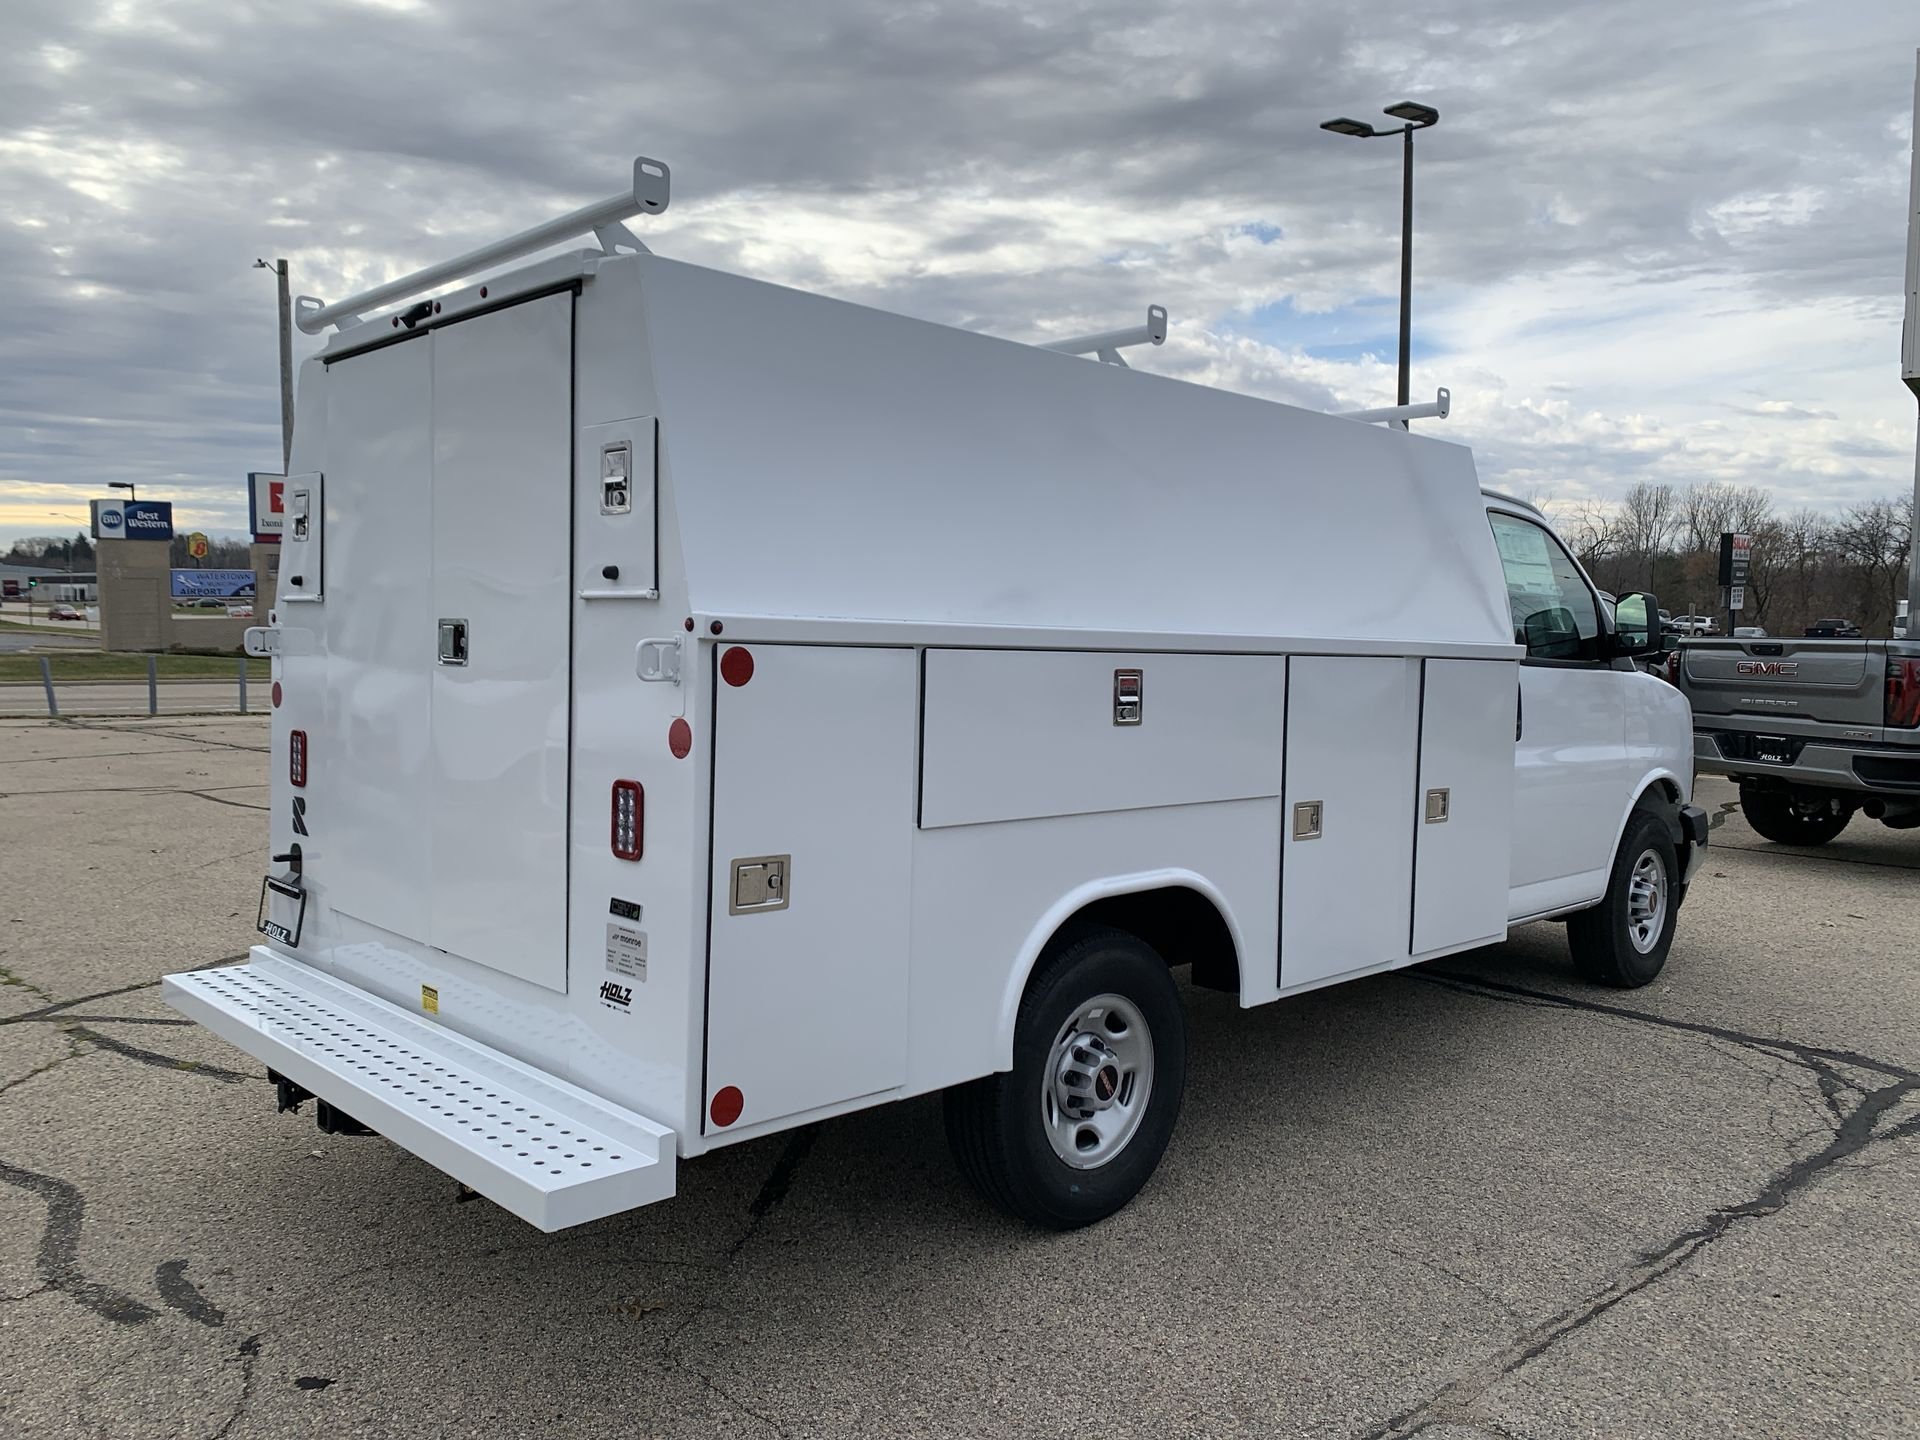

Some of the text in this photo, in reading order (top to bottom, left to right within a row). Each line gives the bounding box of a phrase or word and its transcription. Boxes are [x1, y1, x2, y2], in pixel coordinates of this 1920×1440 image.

[136, 510, 159, 520] Best
[127, 518, 168, 528] Western
[196, 572, 251, 580] WATERTOWN
[180, 587, 222, 595] AIRPORT
[1736, 661, 1798, 677] GMC
[1741, 698, 1798, 707] SIERRA
[1760, 753, 1782, 762] HOLZ
[263, 922, 287, 942] HOLZ
[600, 981, 632, 1003] HOLZ
